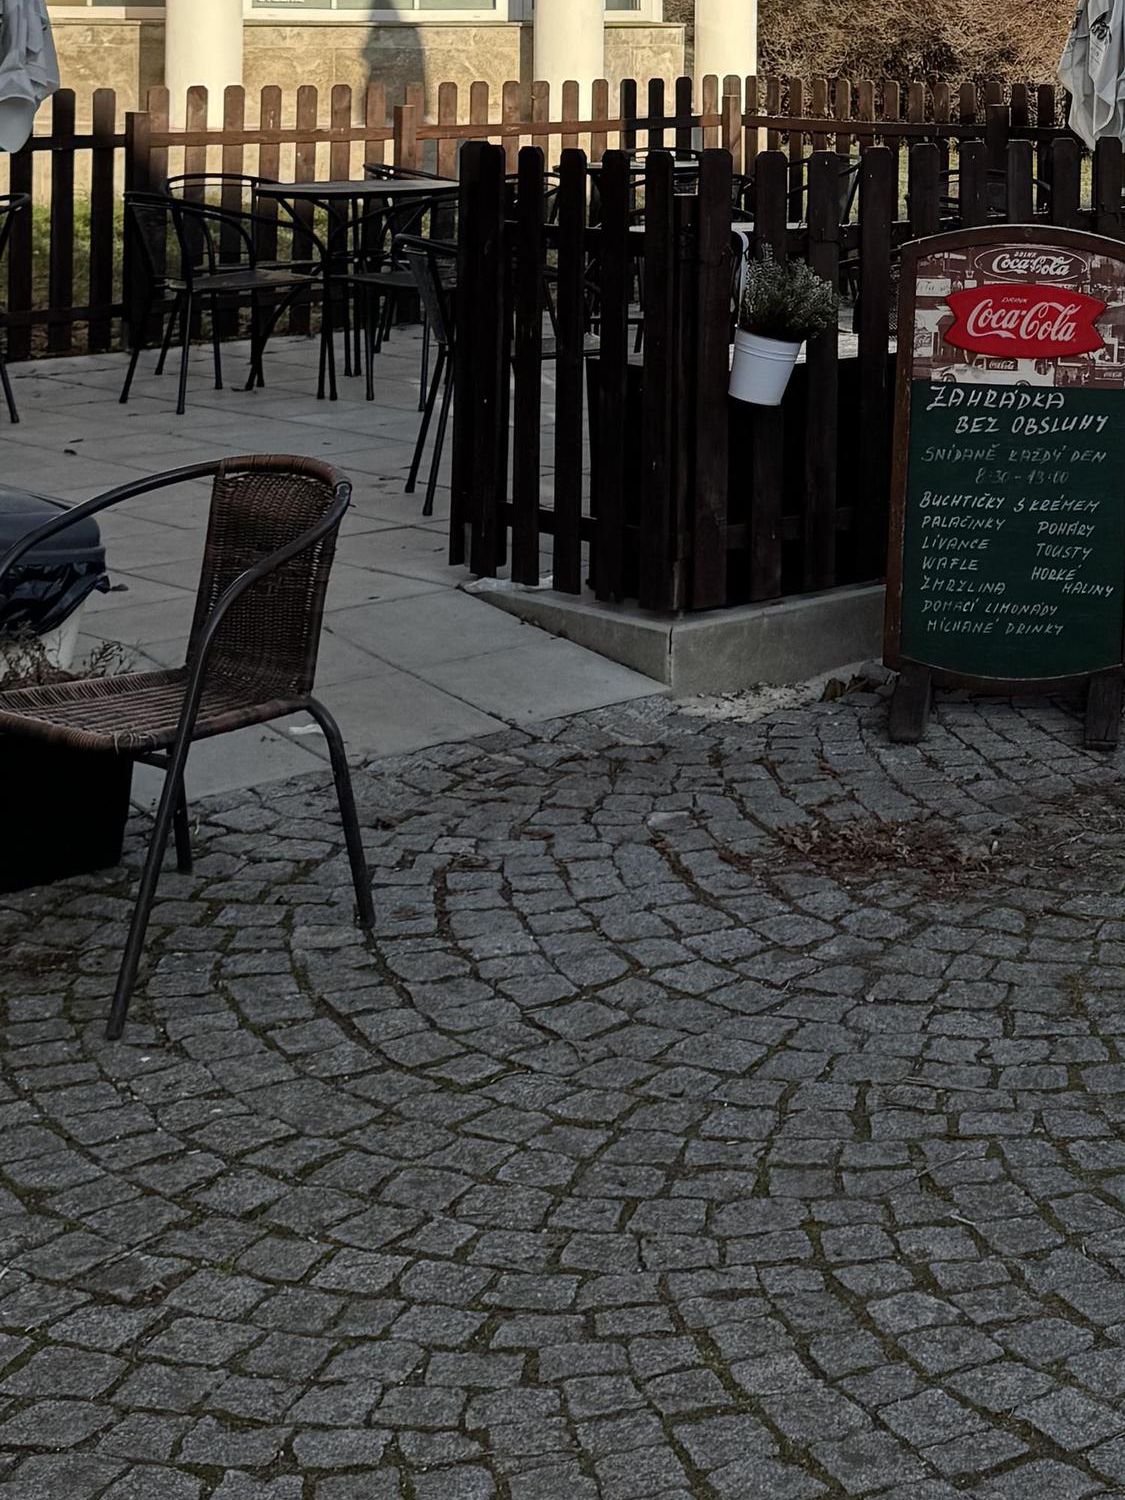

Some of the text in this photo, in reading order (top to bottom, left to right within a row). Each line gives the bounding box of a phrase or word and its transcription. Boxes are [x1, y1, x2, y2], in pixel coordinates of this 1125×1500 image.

[992, 253, 1074, 275] Coca-Cola
[966, 298, 1082, 342] Coca-Cola
[926, 385, 1065, 411] ZAHRÁDKA
[955, 414, 1109, 435] BEZ OBSLUHY
[920, 443, 1107, 464] SNÍDANĚ KAŽDÝ DEN
[919, 491, 1005, 509] BUCHTIČKY
[921, 515, 1006, 531] PALAČINKY
[1036, 542, 1093, 561] TOUSTY
[922, 556, 979, 571] WAFLE
[920, 575, 1006, 596] ZMRZLINA
[1062, 581, 1114, 598] MALINY
[1004, 622, 1064, 636] DRINKY
